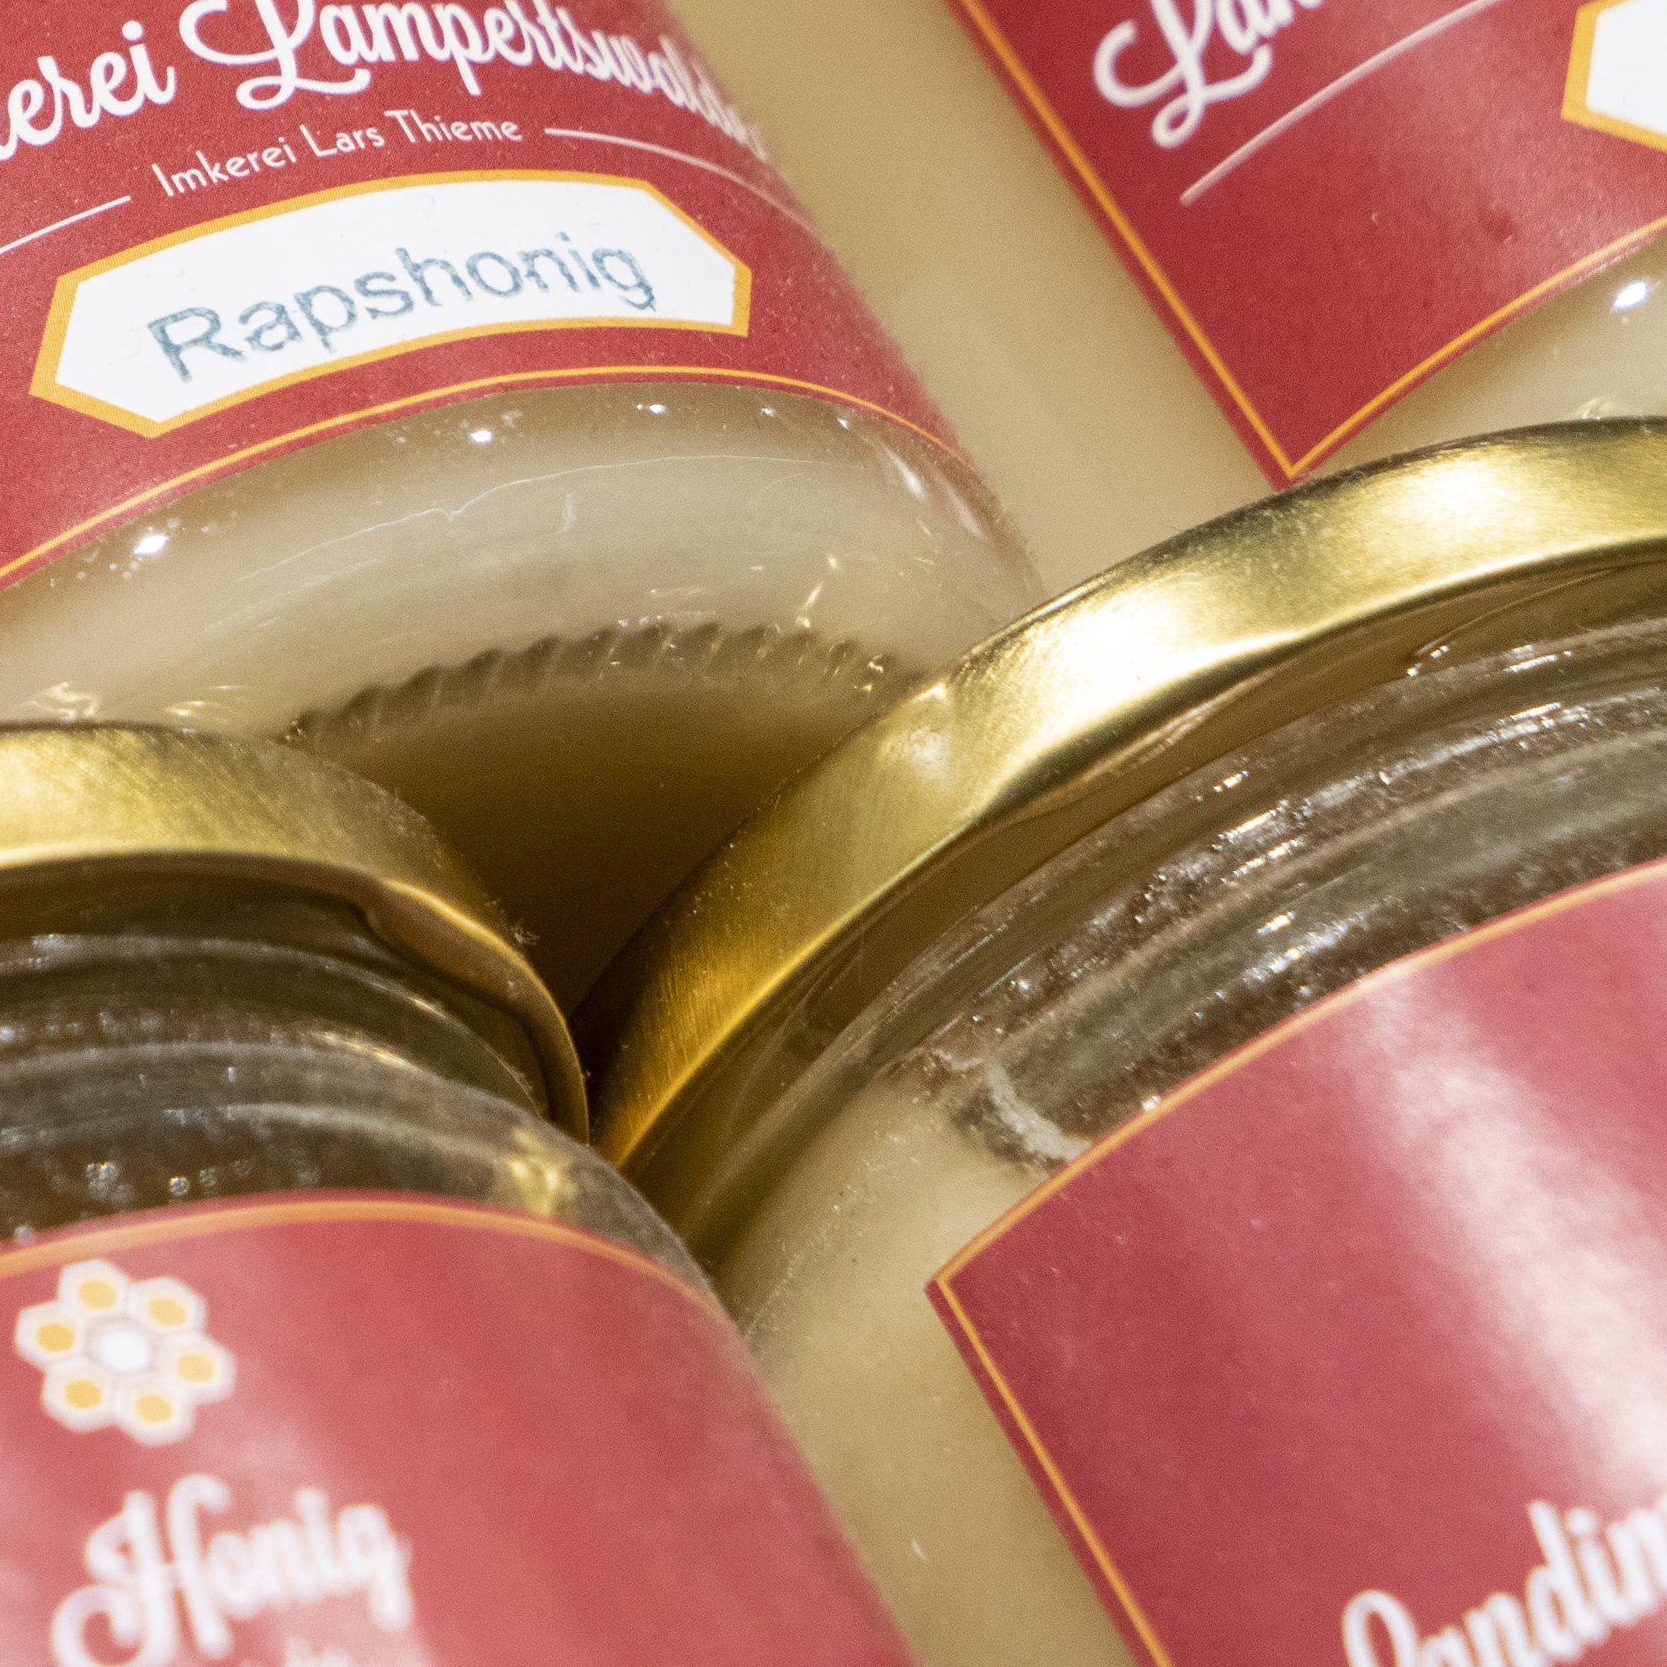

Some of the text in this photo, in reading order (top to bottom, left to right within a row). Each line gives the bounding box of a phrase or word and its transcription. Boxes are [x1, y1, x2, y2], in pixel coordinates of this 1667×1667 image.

[151, 109, 523, 198] Imkerei Lars Thieme
[147, 230, 660, 385] Rapshonig
[50, 1471, 415, 1667] Honig
